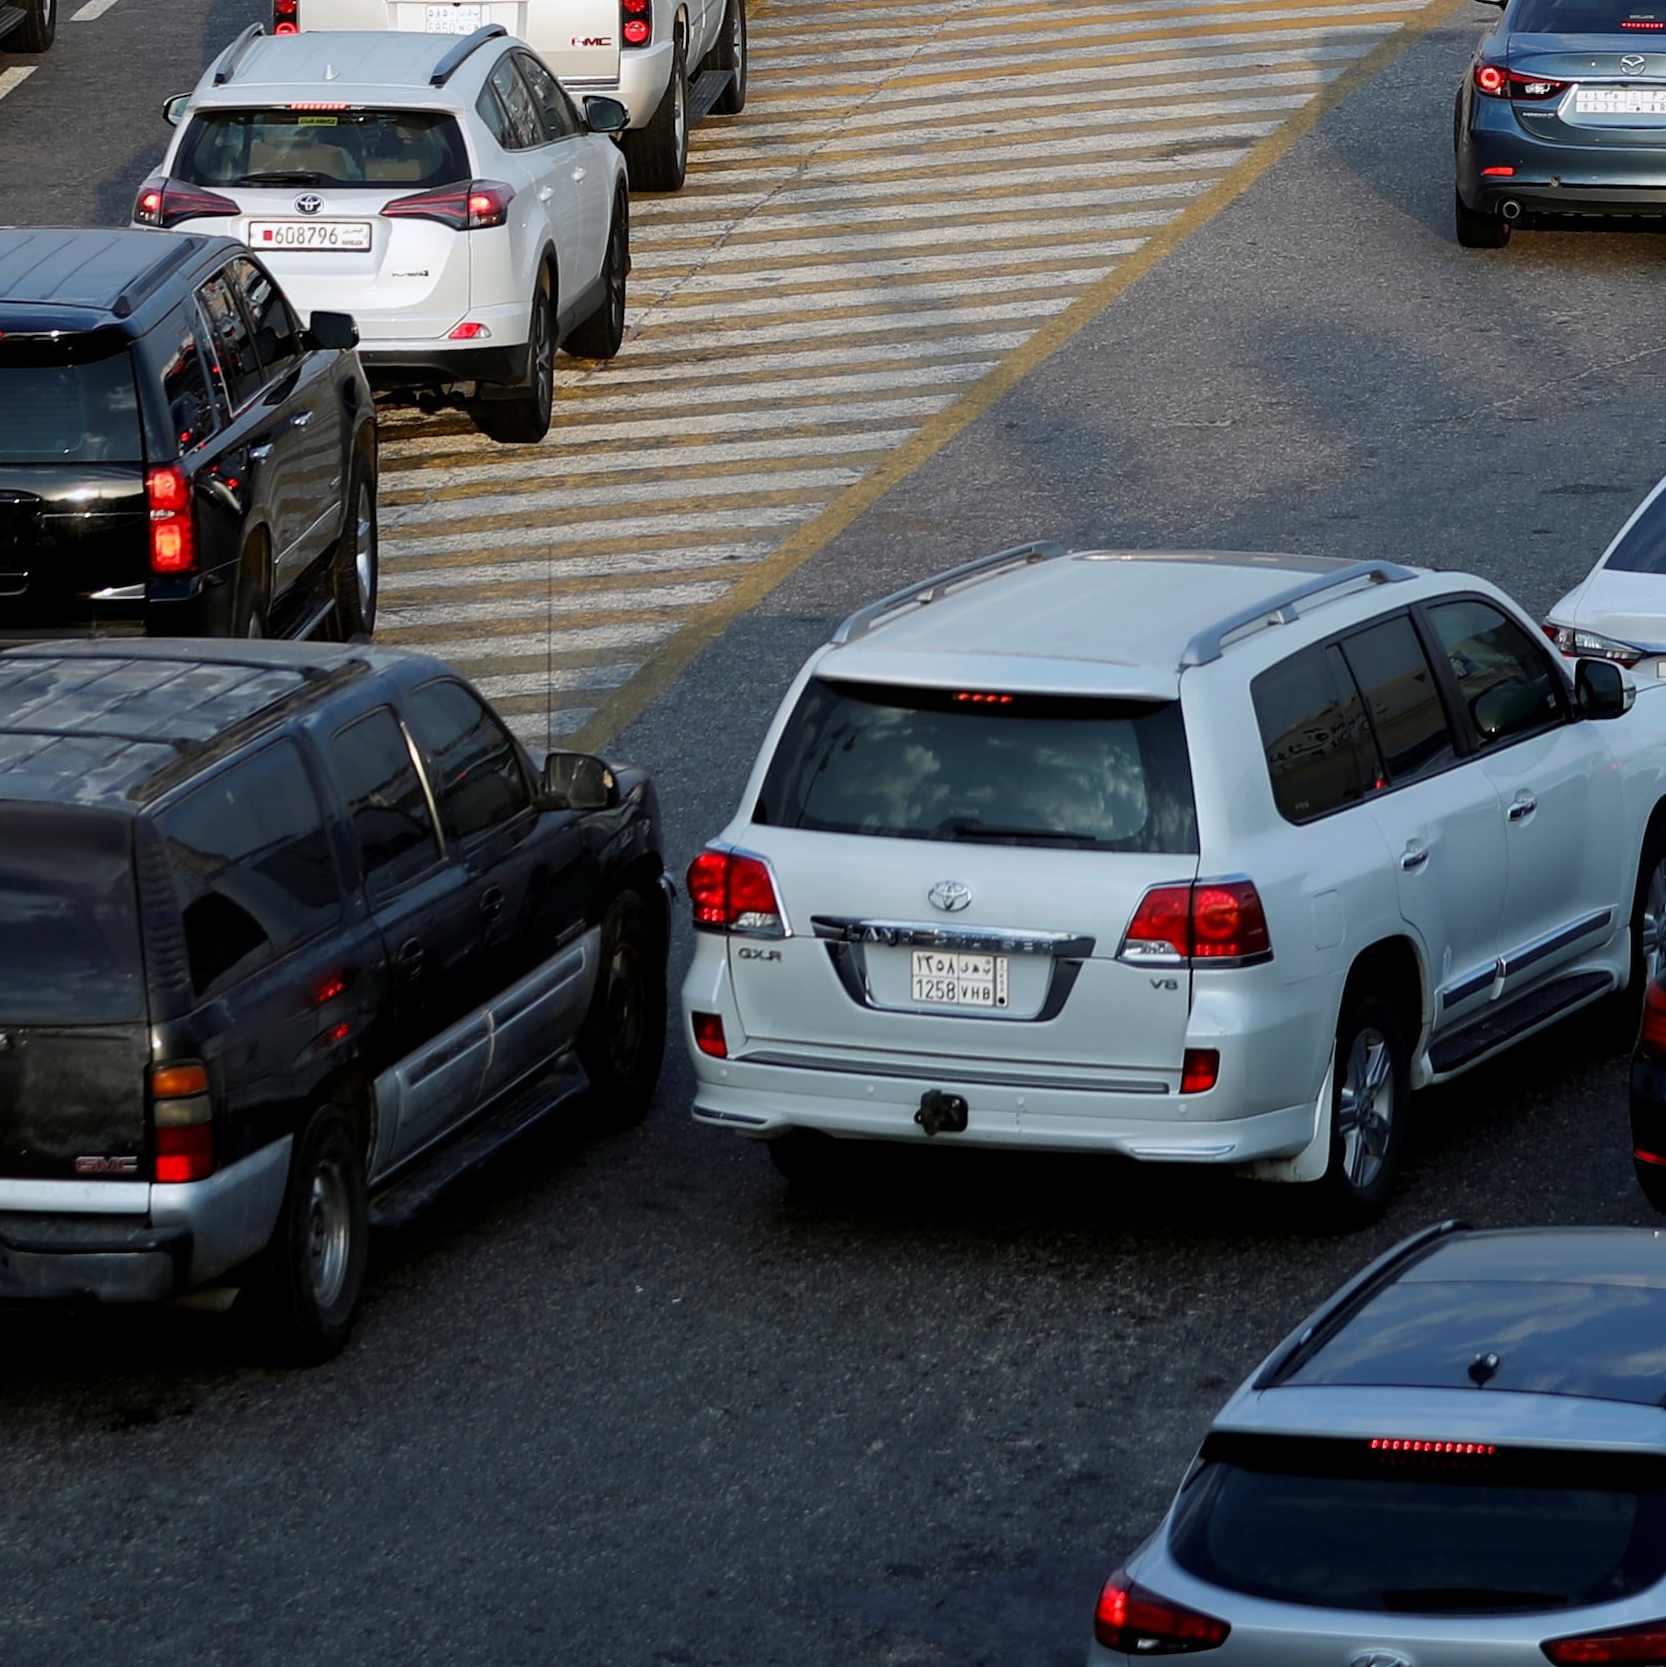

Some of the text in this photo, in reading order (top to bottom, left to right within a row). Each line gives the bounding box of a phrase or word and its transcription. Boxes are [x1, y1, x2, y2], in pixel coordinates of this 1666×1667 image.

[571, 37, 612, 46] GMC
[274, 226, 339, 245] 608796
[738, 947, 782, 963] GXR
[914, 955, 955, 975] ١٢٥٨
[915, 978, 991, 1001] 1258 VHB
[1147, 978, 1180, 991] V8
[75, 1155, 138, 1172] GMC
